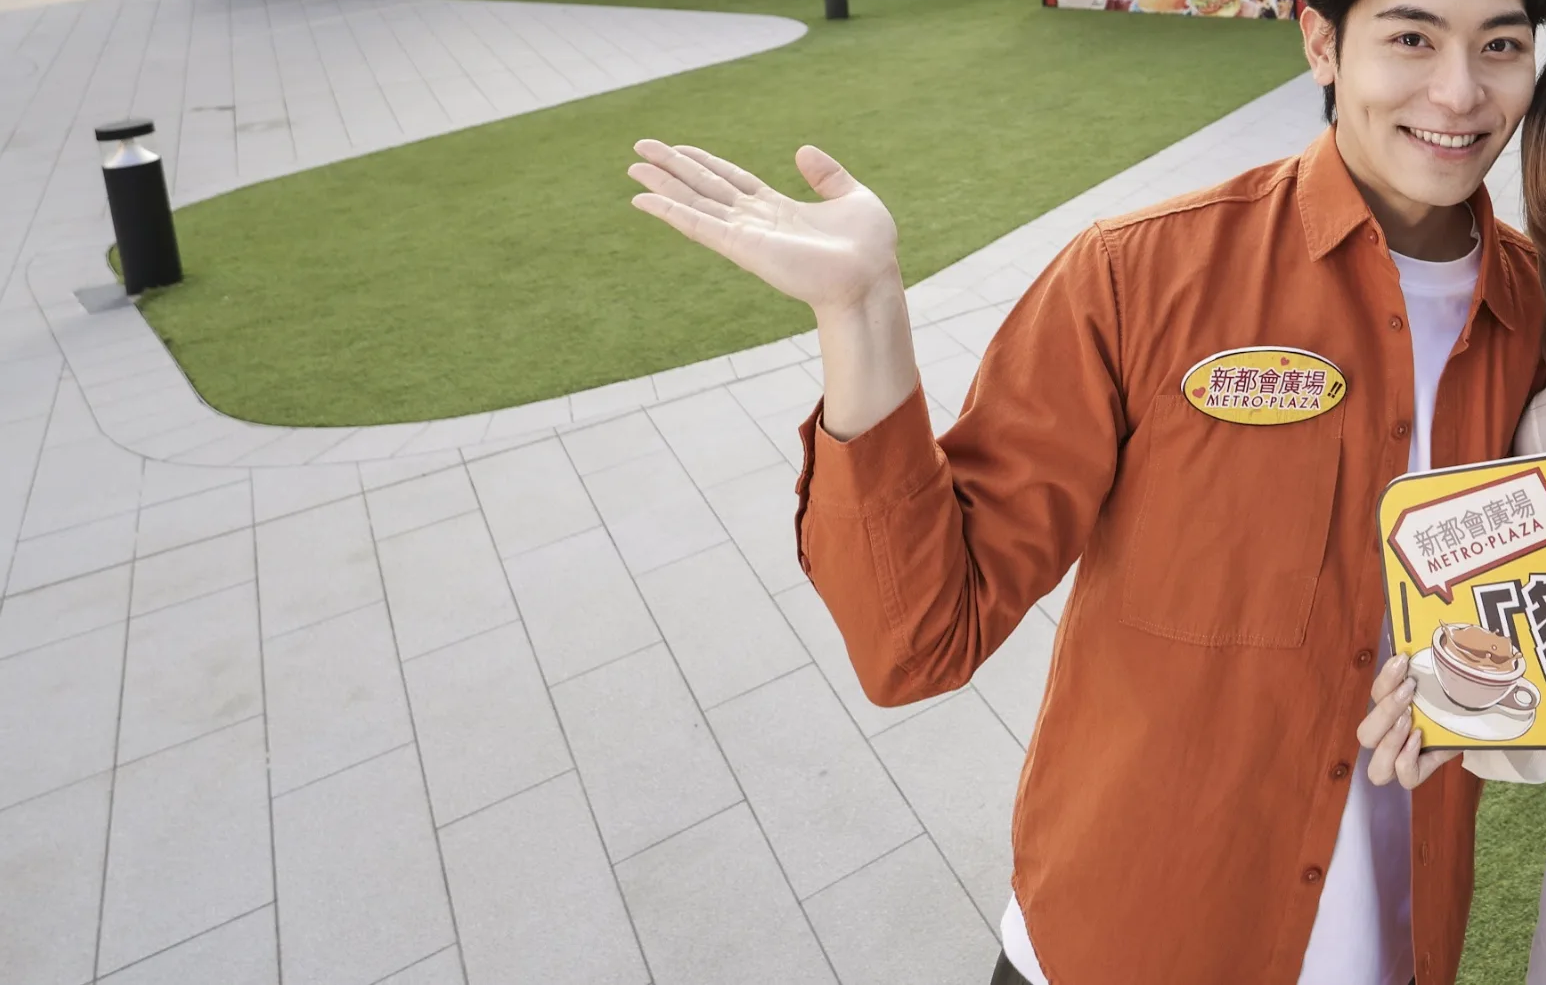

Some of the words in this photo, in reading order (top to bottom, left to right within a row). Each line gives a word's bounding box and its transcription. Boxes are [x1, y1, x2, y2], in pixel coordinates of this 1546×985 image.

[1209, 366, 1326, 396] 新都會廣場
[1413, 488, 1536, 558] 新都會廣場
